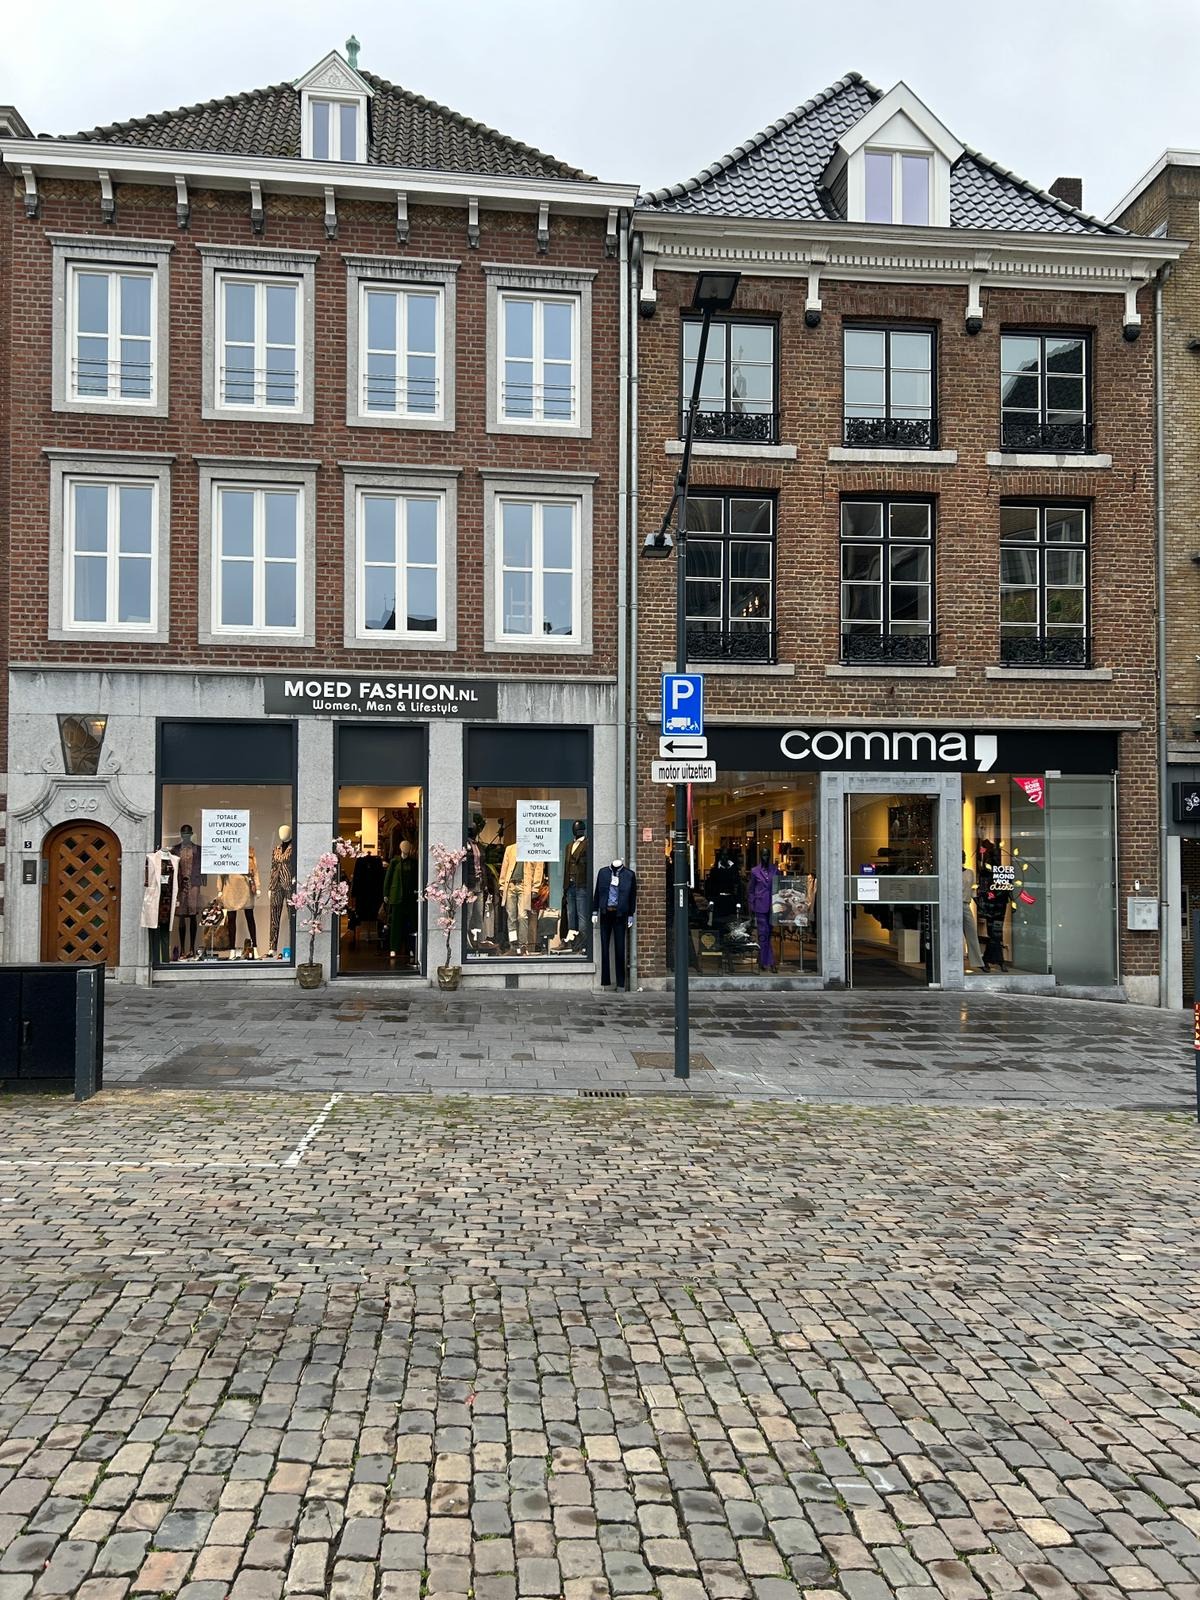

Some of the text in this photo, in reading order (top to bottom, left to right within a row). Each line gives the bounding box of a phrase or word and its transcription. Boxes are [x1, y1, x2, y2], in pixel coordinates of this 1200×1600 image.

[284, 680, 478, 702] MOED FASHION.NL
[672, 679, 694, 710] P
[313, 699, 459, 715] Women, Men & Lifestyle
[658, 763, 713, 780] motor uitzetten
[64, 797, 98, 813] 1949
[993, 865, 1015, 873] ROER
